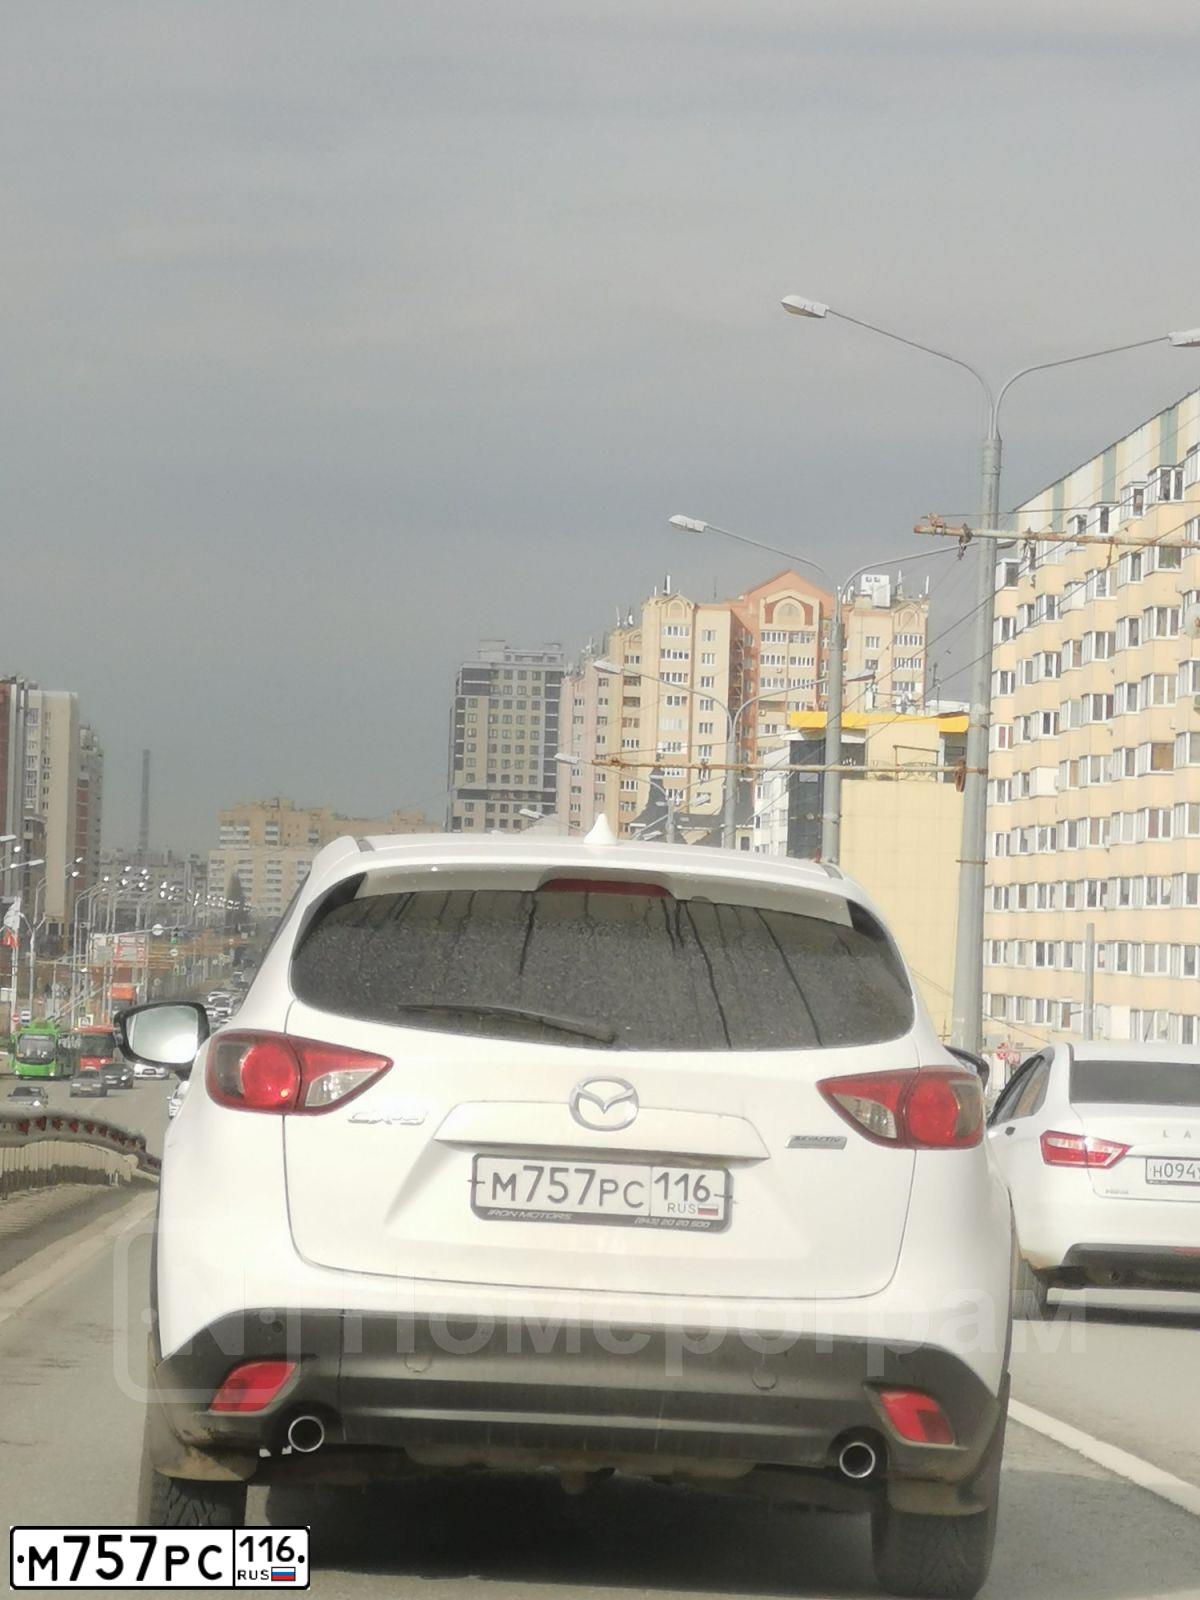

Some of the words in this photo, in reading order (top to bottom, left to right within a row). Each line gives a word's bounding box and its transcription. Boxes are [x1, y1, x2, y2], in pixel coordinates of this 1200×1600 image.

[1152, 1162, 1200, 1179] Н094
[491, 1165, 646, 1209] М757РС
[654, 1171, 711, 1203] 116
[519, 1210, 574, 1221] MOTORS
[667, 1202, 698, 1215] RUS
